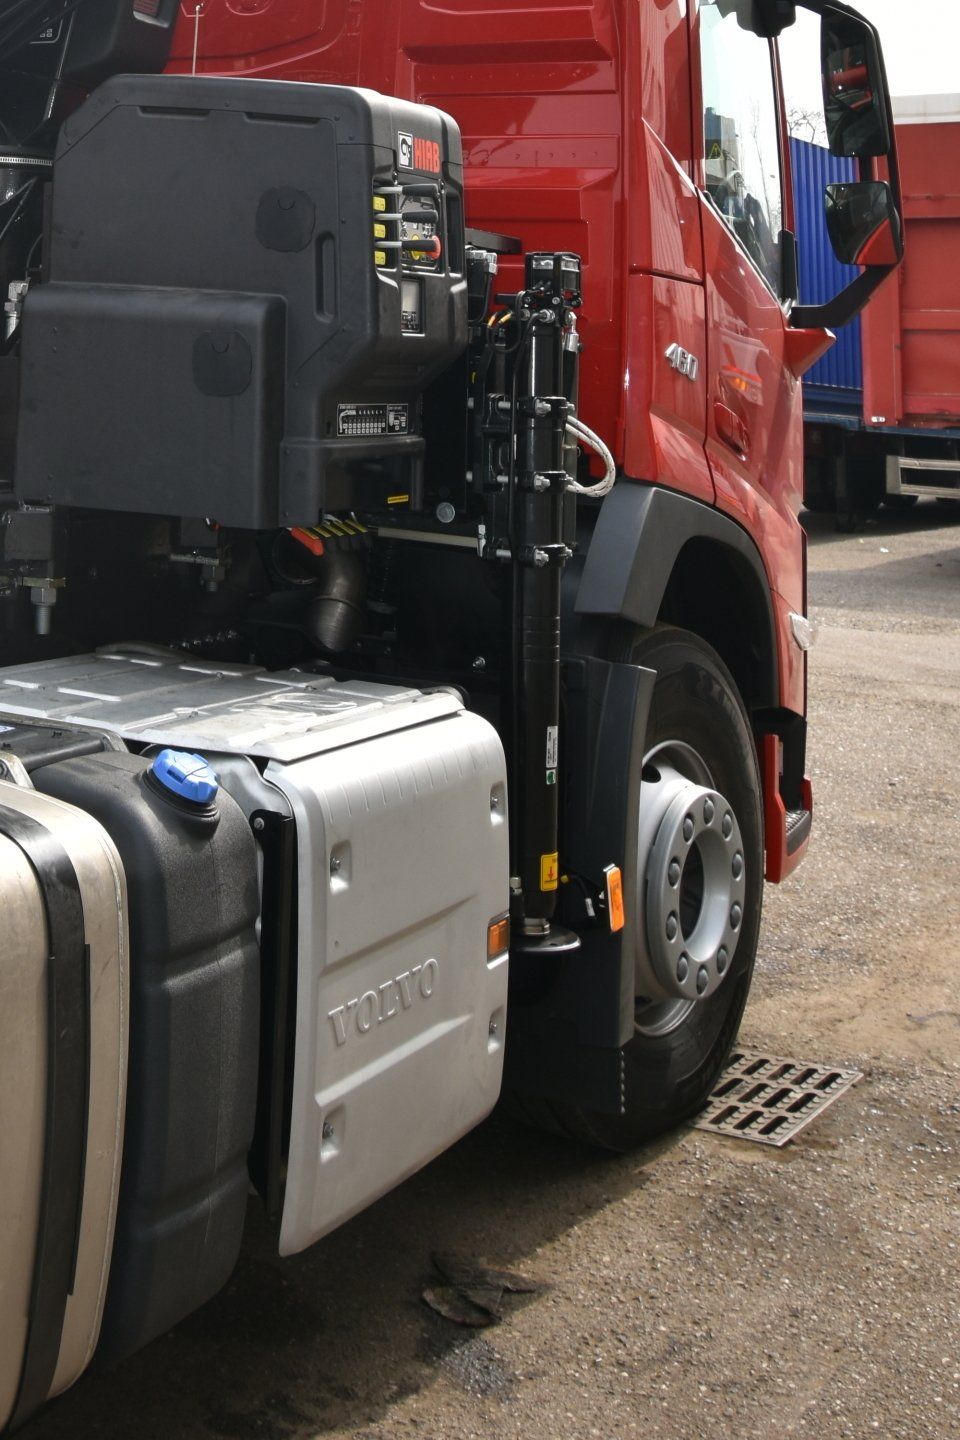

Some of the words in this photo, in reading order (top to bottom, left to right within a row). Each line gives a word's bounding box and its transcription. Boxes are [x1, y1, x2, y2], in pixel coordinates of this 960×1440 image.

[414, 137, 441, 173] HIAB
[664, 342, 699, 382] 460
[327, 957, 439, 1047] VOLVO
